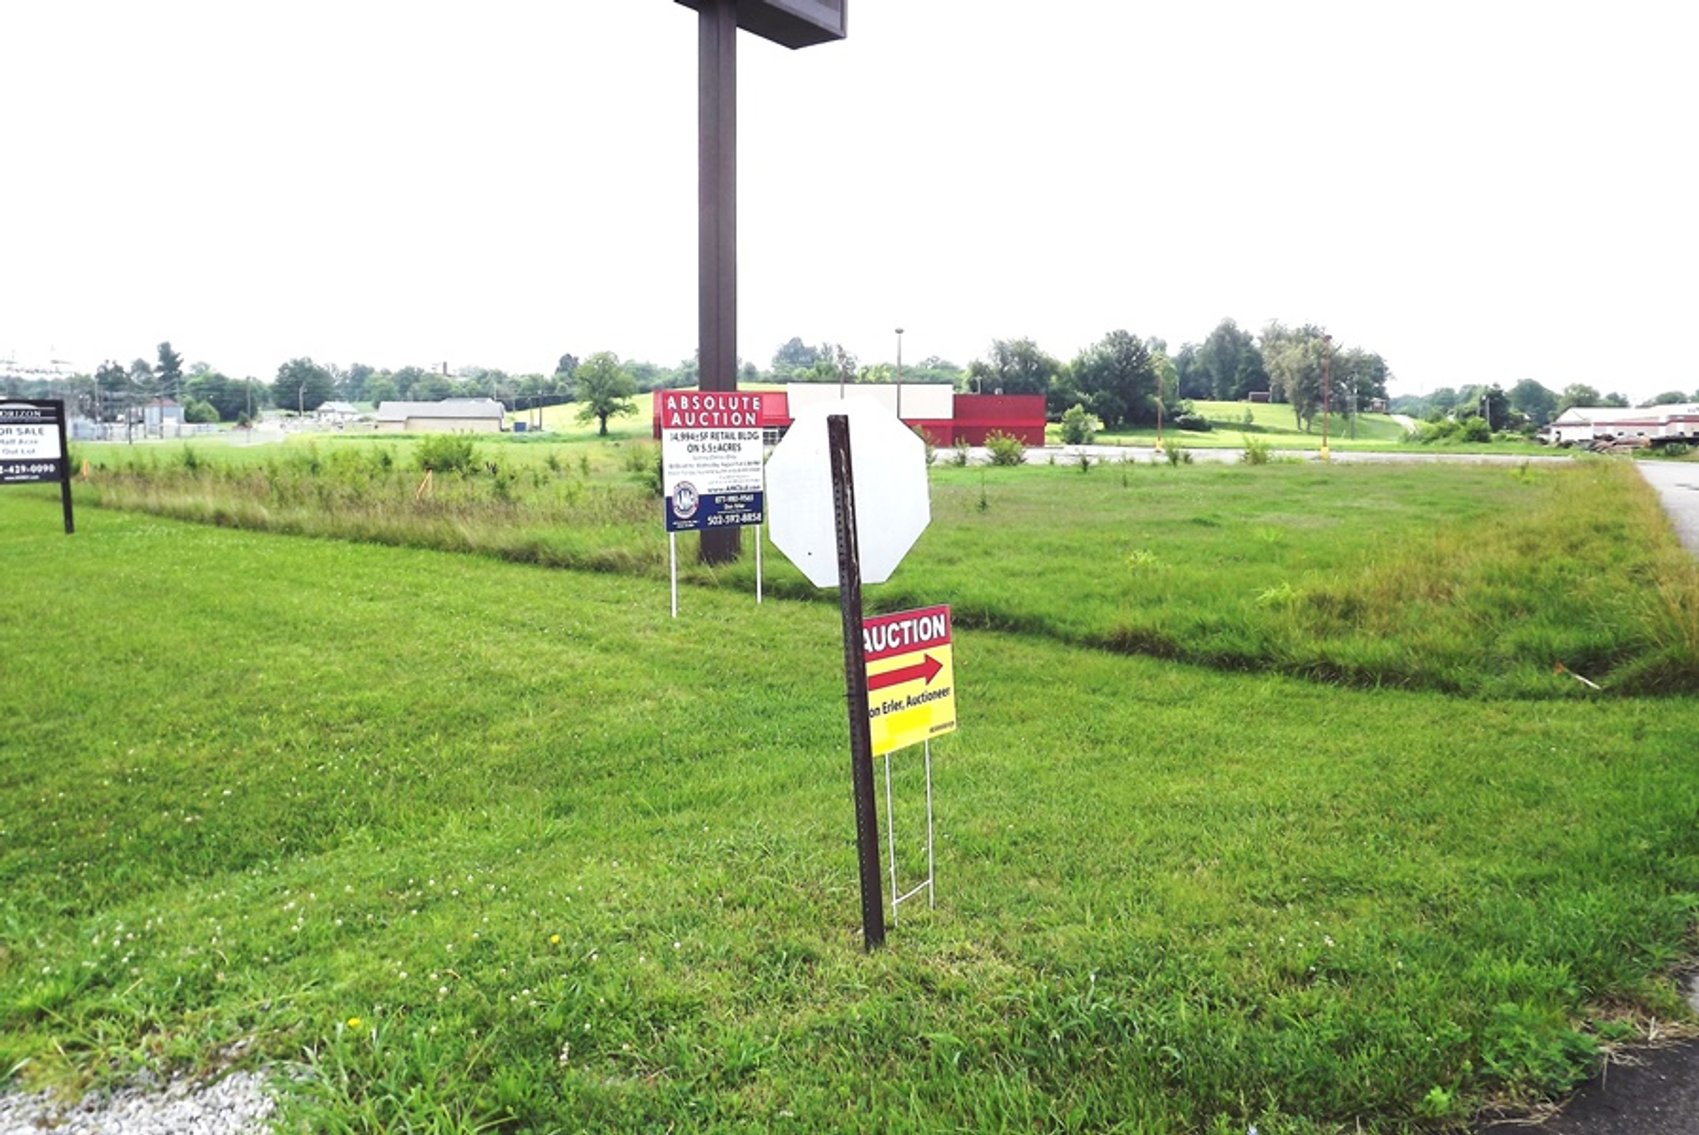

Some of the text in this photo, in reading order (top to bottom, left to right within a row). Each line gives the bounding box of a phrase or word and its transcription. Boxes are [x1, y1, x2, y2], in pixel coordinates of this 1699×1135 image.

[667, 395, 761, 410] ABSOLUTE
[671, 412, 756, 425] AUCTION
[16, 427, 45, 436] SALE
[710, 431, 736, 441] RETAIL
[738, 431, 760, 440] BLDG
[687, 443, 699, 453] ON
[863, 614, 946, 653] AUCTION
[882, 699, 905, 714] Erler,
[906, 687, 951, 708] Auctioneer
